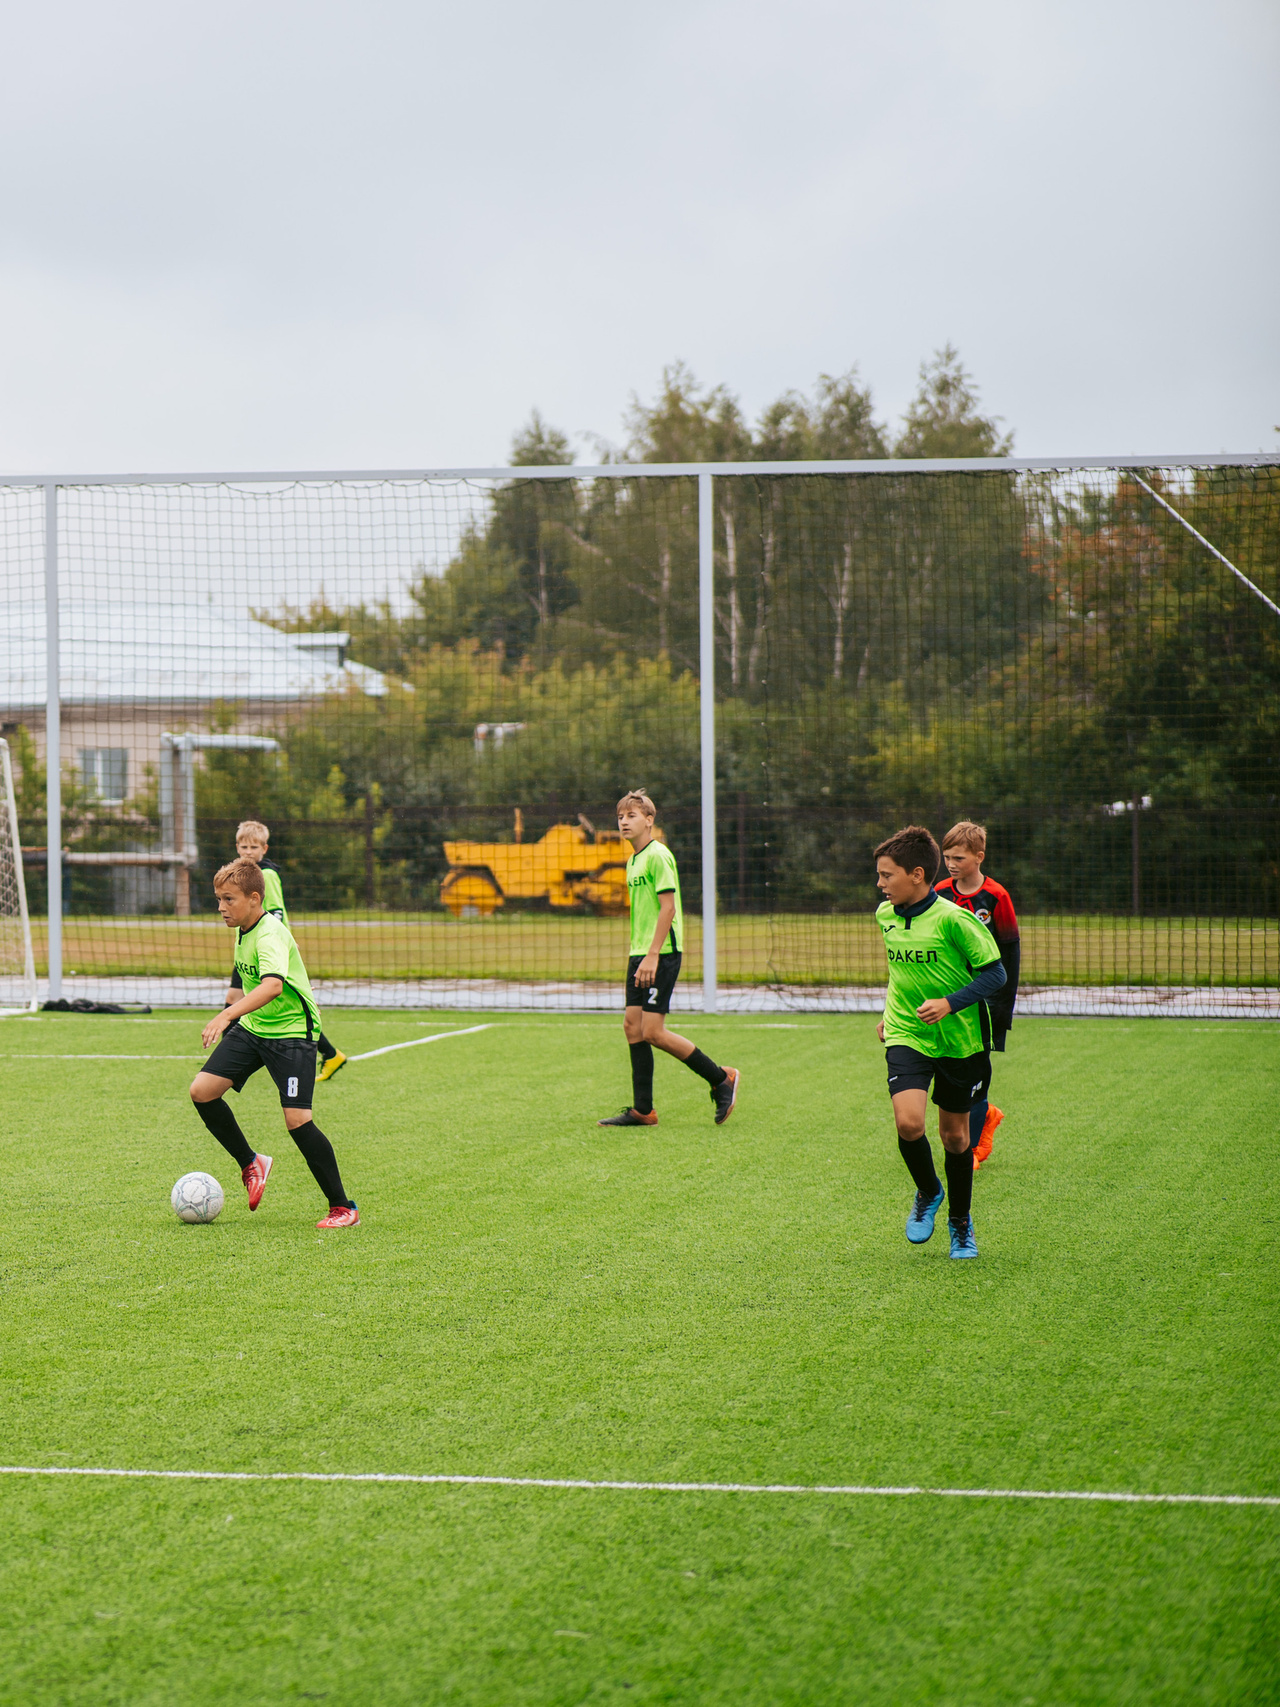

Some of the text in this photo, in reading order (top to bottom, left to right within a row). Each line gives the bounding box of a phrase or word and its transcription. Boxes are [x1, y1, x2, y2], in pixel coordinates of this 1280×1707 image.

[888, 948, 938, 963] ФАКЕЛ
[648, 987, 658, 1005] 2
[287, 1076, 299, 1098] 8
